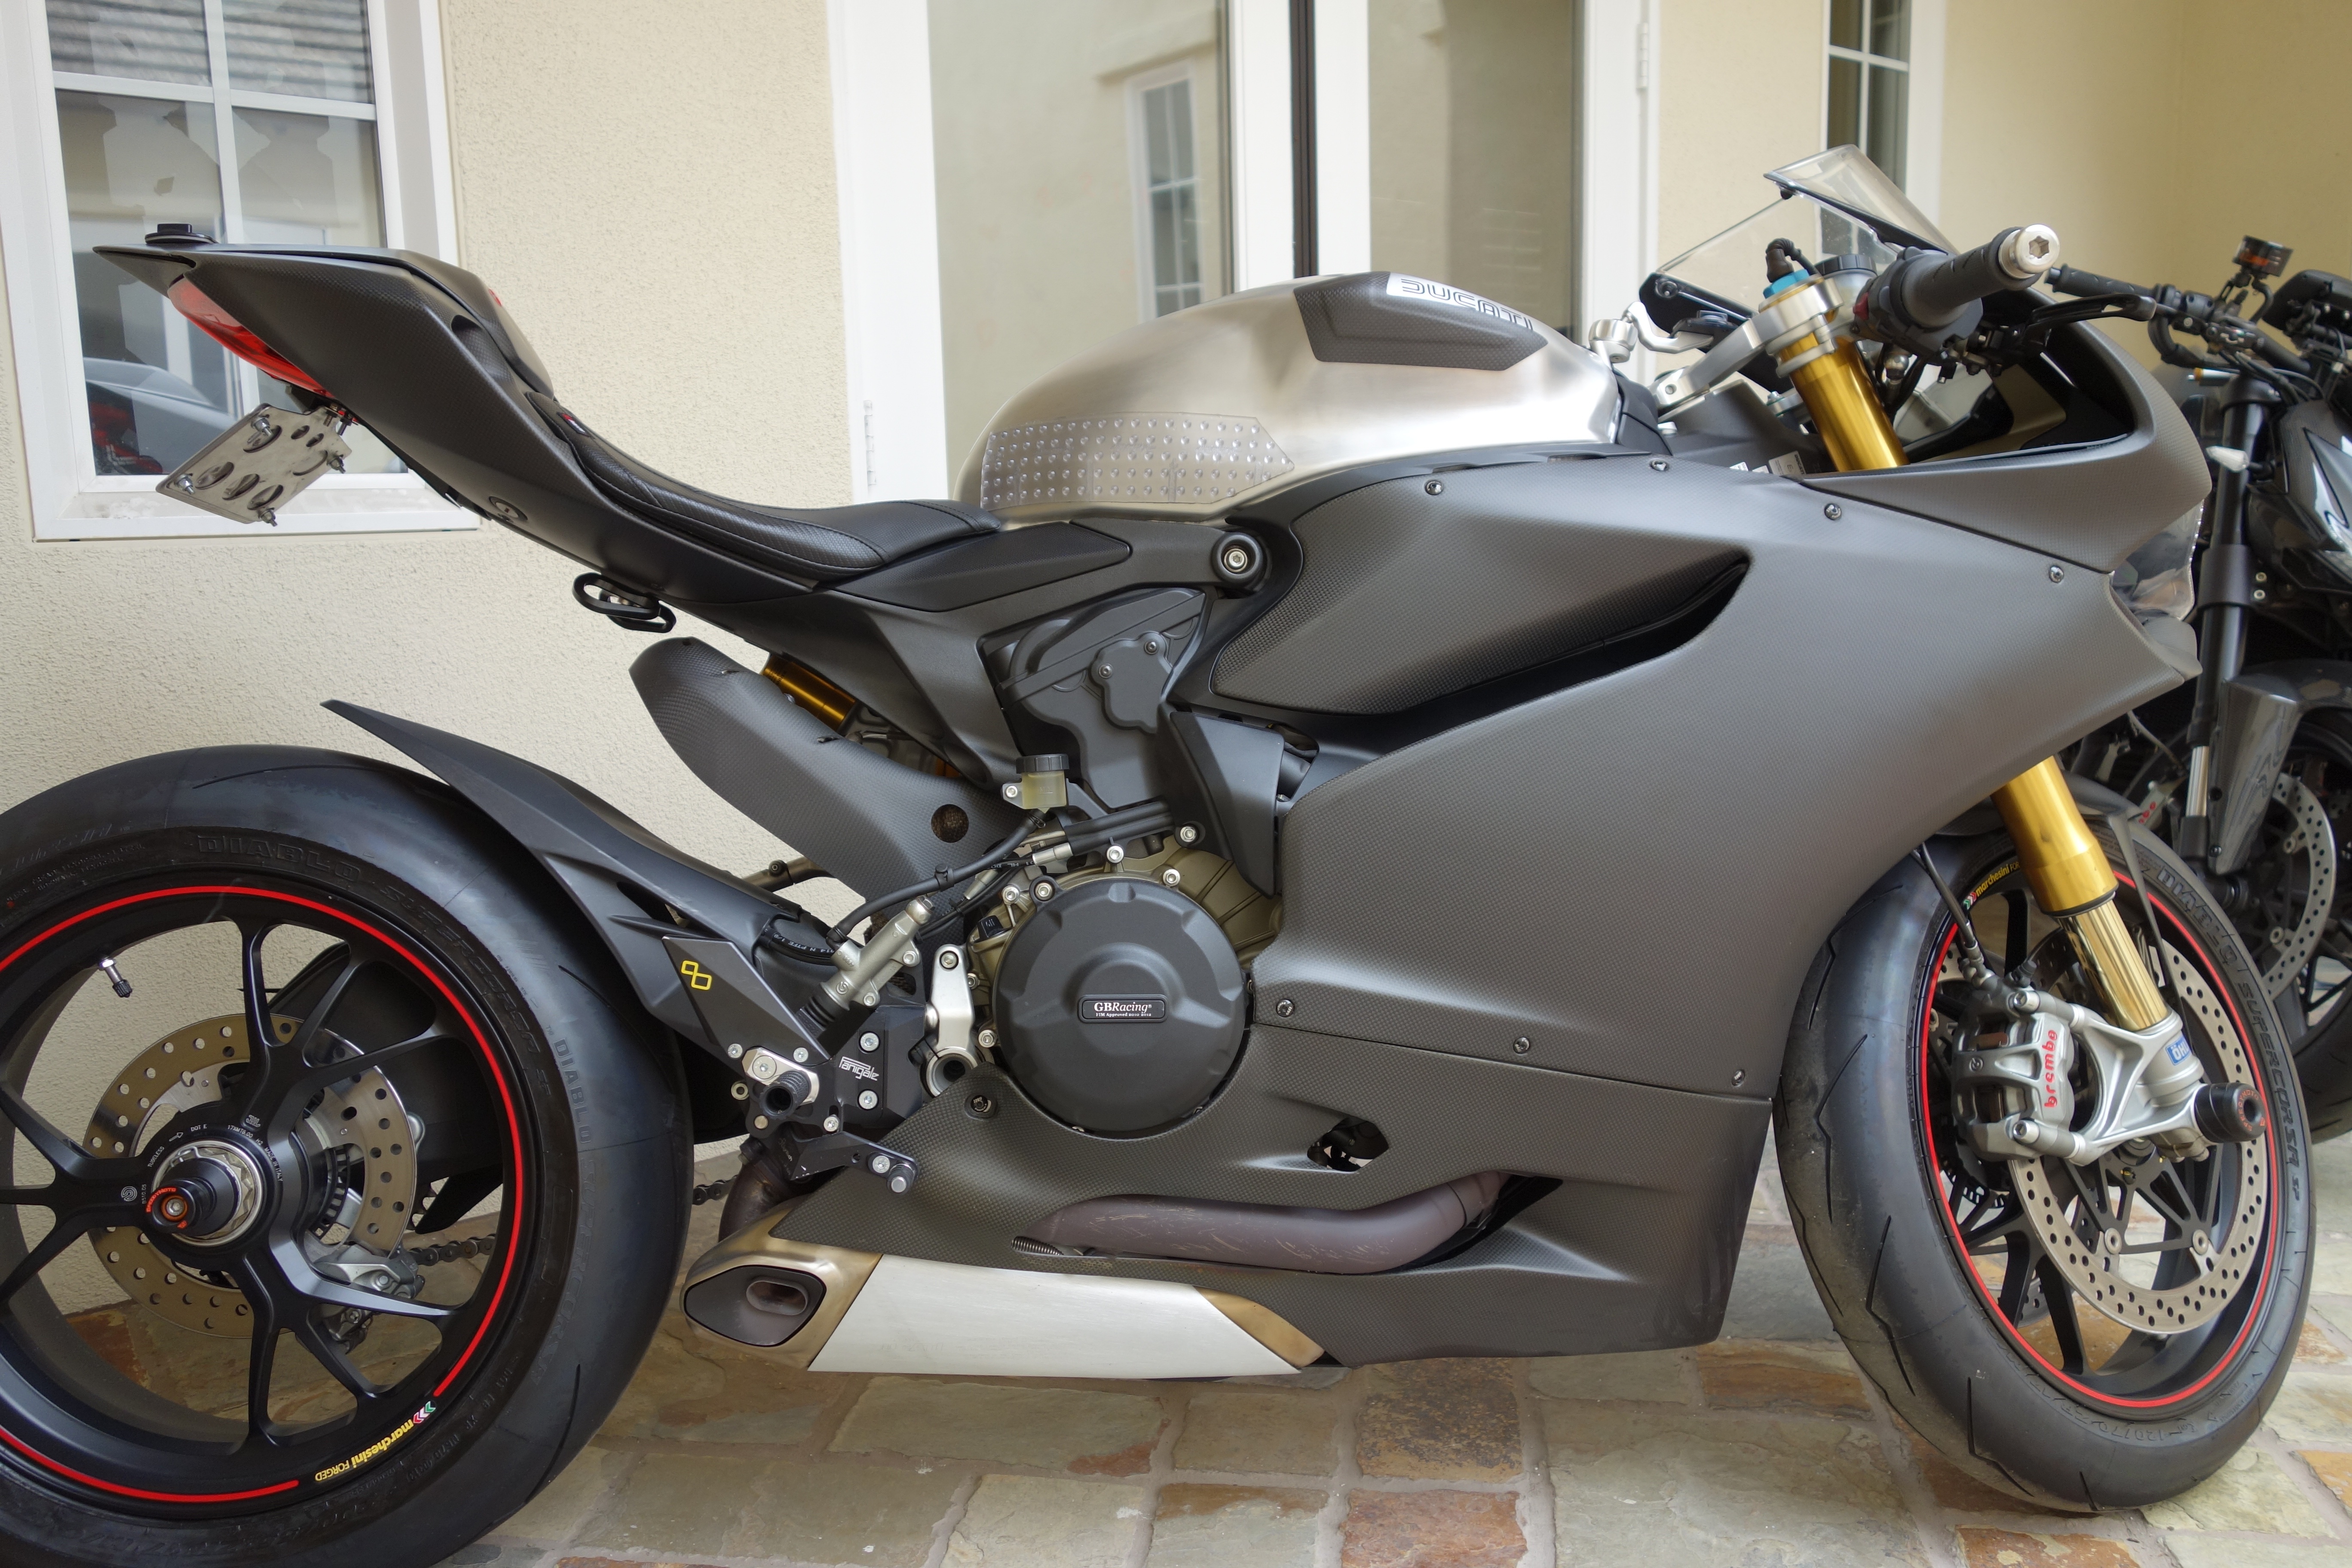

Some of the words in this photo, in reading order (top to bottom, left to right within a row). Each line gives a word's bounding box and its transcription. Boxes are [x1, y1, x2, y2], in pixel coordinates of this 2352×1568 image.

[1400, 278, 1534, 330] DUCATI
[197, 834, 361, 882] DIABLO
[1975, 863, 2010, 897] marchesini
[2010, 861, 2020, 872] FOR
[2158, 867, 2238, 965] DIABLO
[788, 940, 807, 950] PTFE
[380, 886, 541, 1053] SUPERCORSA
[839, 1056, 879, 1081] Panigale
[2042, 1029, 2058, 1108] brembo
[2170, 1041, 2190, 1060] ÖHL
[553, 1037, 592, 1143] DIABLO
[2236, 982, 2300, 1168] SUPERCORSA
[2238, 1089, 2259, 1131] SPEEDYMOTO
[147, 1145, 165, 1168] TUBELESS
[264, 1147, 276, 1161] MADE
[275, 1167, 284, 1182] ITALY
[145, 1187, 178, 1213] SPEEDYMOTO
[531, 1159, 597, 1385] SUPERCORSA
[351, 1419, 414, 1468] marchesini
[314, 1460, 350, 1482] FORGED
